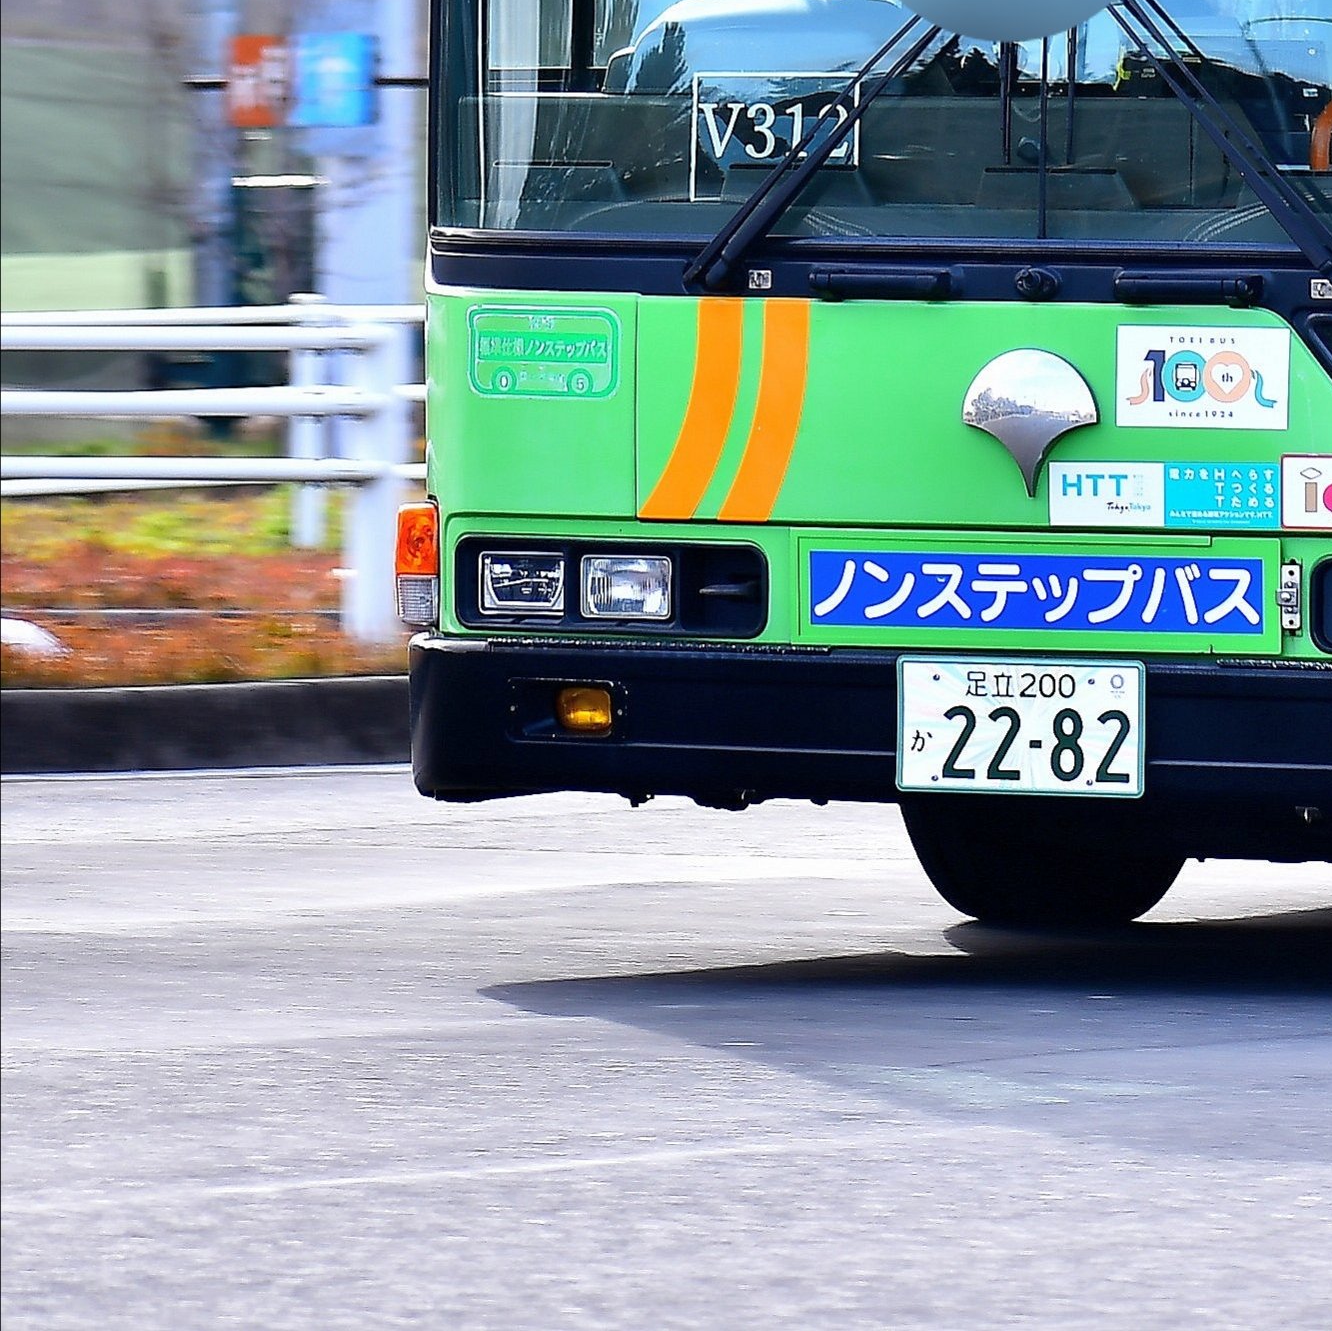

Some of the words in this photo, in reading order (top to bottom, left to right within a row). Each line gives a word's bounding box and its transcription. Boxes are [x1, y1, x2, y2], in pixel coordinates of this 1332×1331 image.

[697, 101, 850, 159] V312
[1169, 335, 1203, 345] TOEI
[1209, 336, 1236, 345] BUS
[1061, 473, 1129, 497] HTT
[812, 559, 1262, 626] ノンステップバス
[909, 729, 933, 753] か
[942, 704, 1132, 785] 22-82
